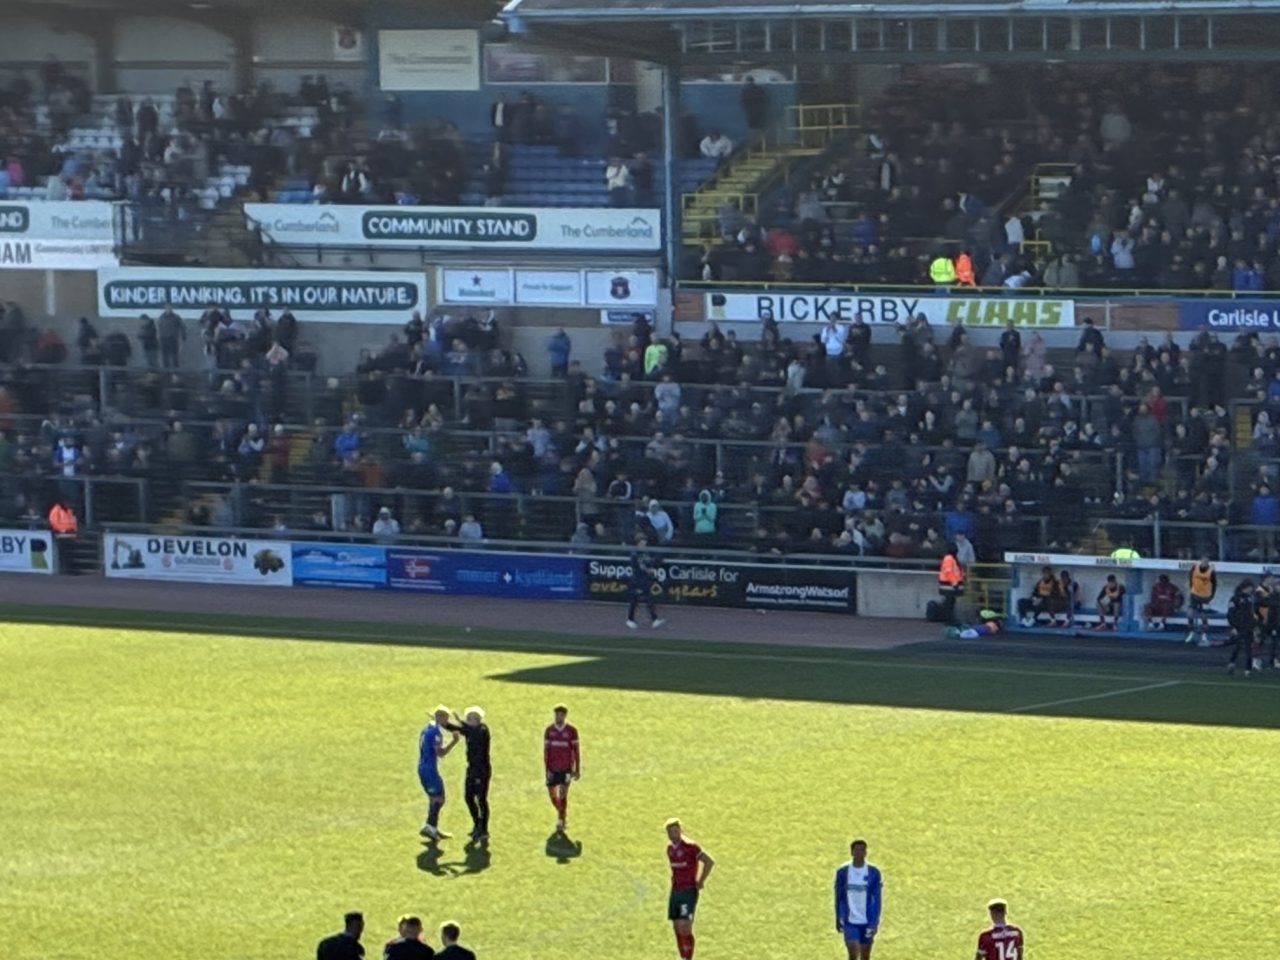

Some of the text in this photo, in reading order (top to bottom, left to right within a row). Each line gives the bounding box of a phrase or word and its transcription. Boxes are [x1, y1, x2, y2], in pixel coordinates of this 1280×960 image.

[368, 217, 530, 236] COMMUNITY STAND
[560, 224, 653, 239] The Cumberland
[110, 286, 411, 305] KINDER BANKING. IT'S IN OUR NATURE.
[756, 297, 920, 322] RICKERBY
[946, 300, 1063, 324] CLAAS
[1208, 309, 1269, 327] Carlisle
[147, 539, 248, 557] DEVELON
[669, 565, 716, 581] Carlisle
[719, 567, 740, 582] for
[590, 582, 628, 593] over
[668, 583, 718, 601] years
[746, 583, 849, 600] ArmstrongWatson
